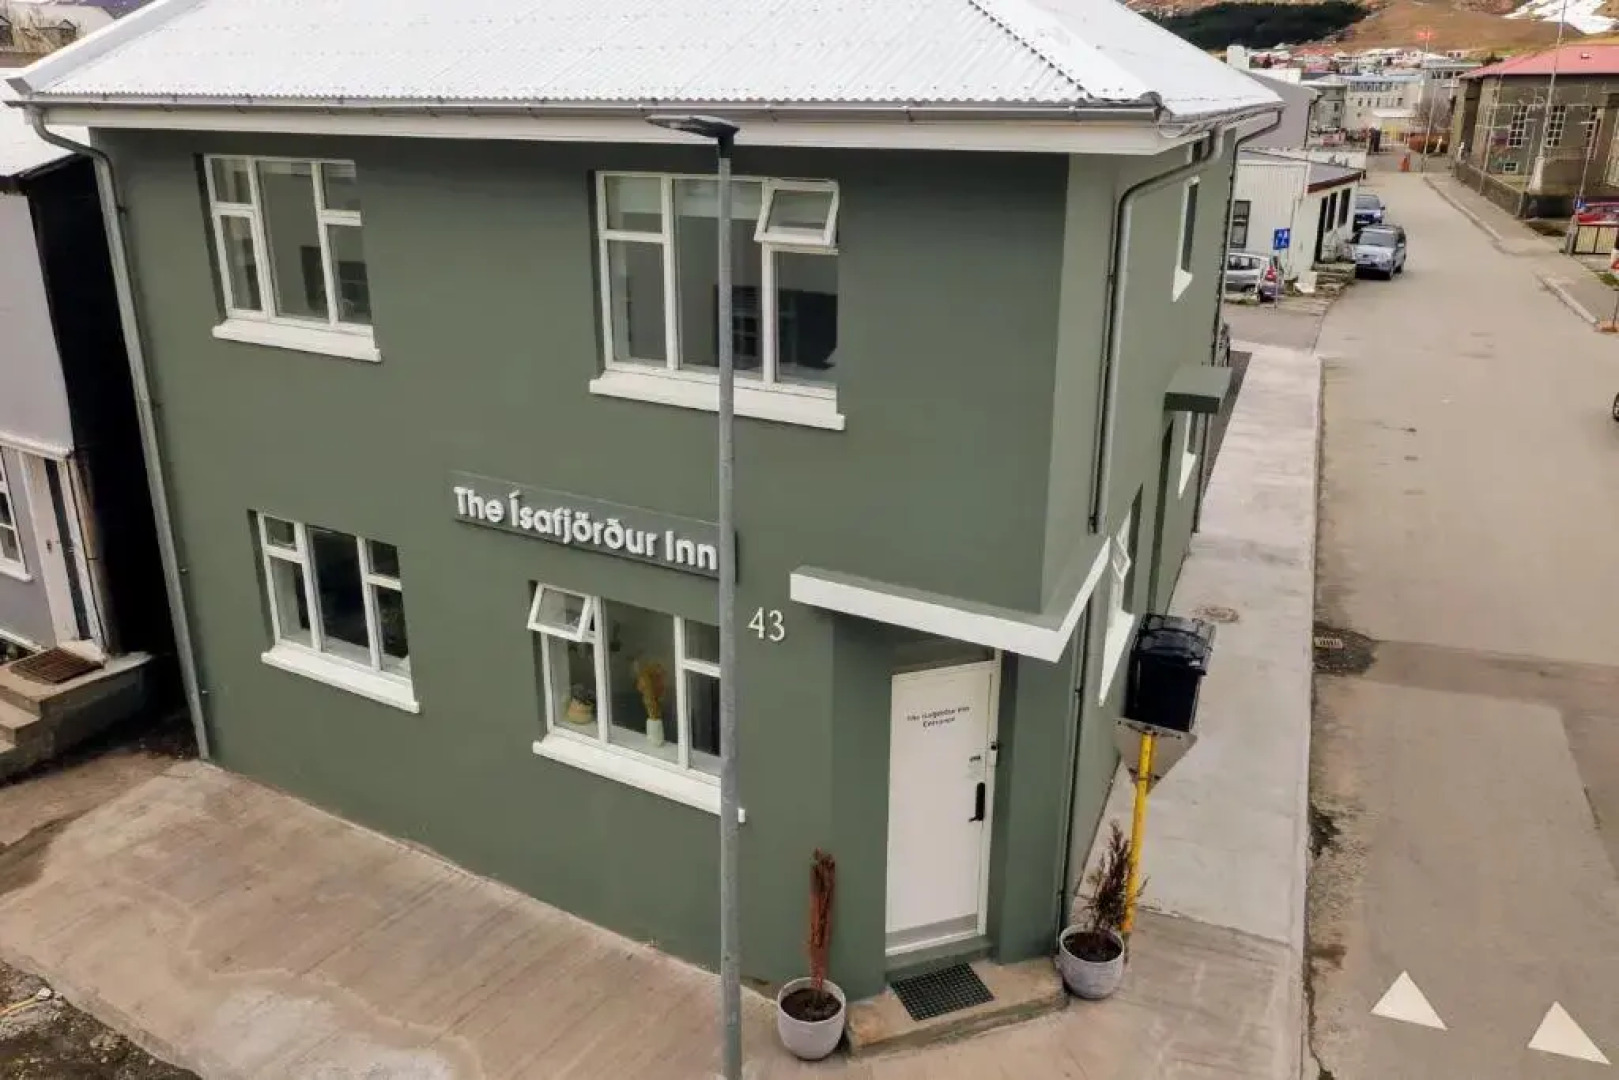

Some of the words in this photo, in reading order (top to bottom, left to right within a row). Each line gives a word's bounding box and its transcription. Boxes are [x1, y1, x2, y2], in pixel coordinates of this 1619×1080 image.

[453, 486, 504, 522] The
[510, 490, 658, 556] Ísafjörður
[665, 531, 719, 570] Inn
[747, 607, 786, 641] 43
